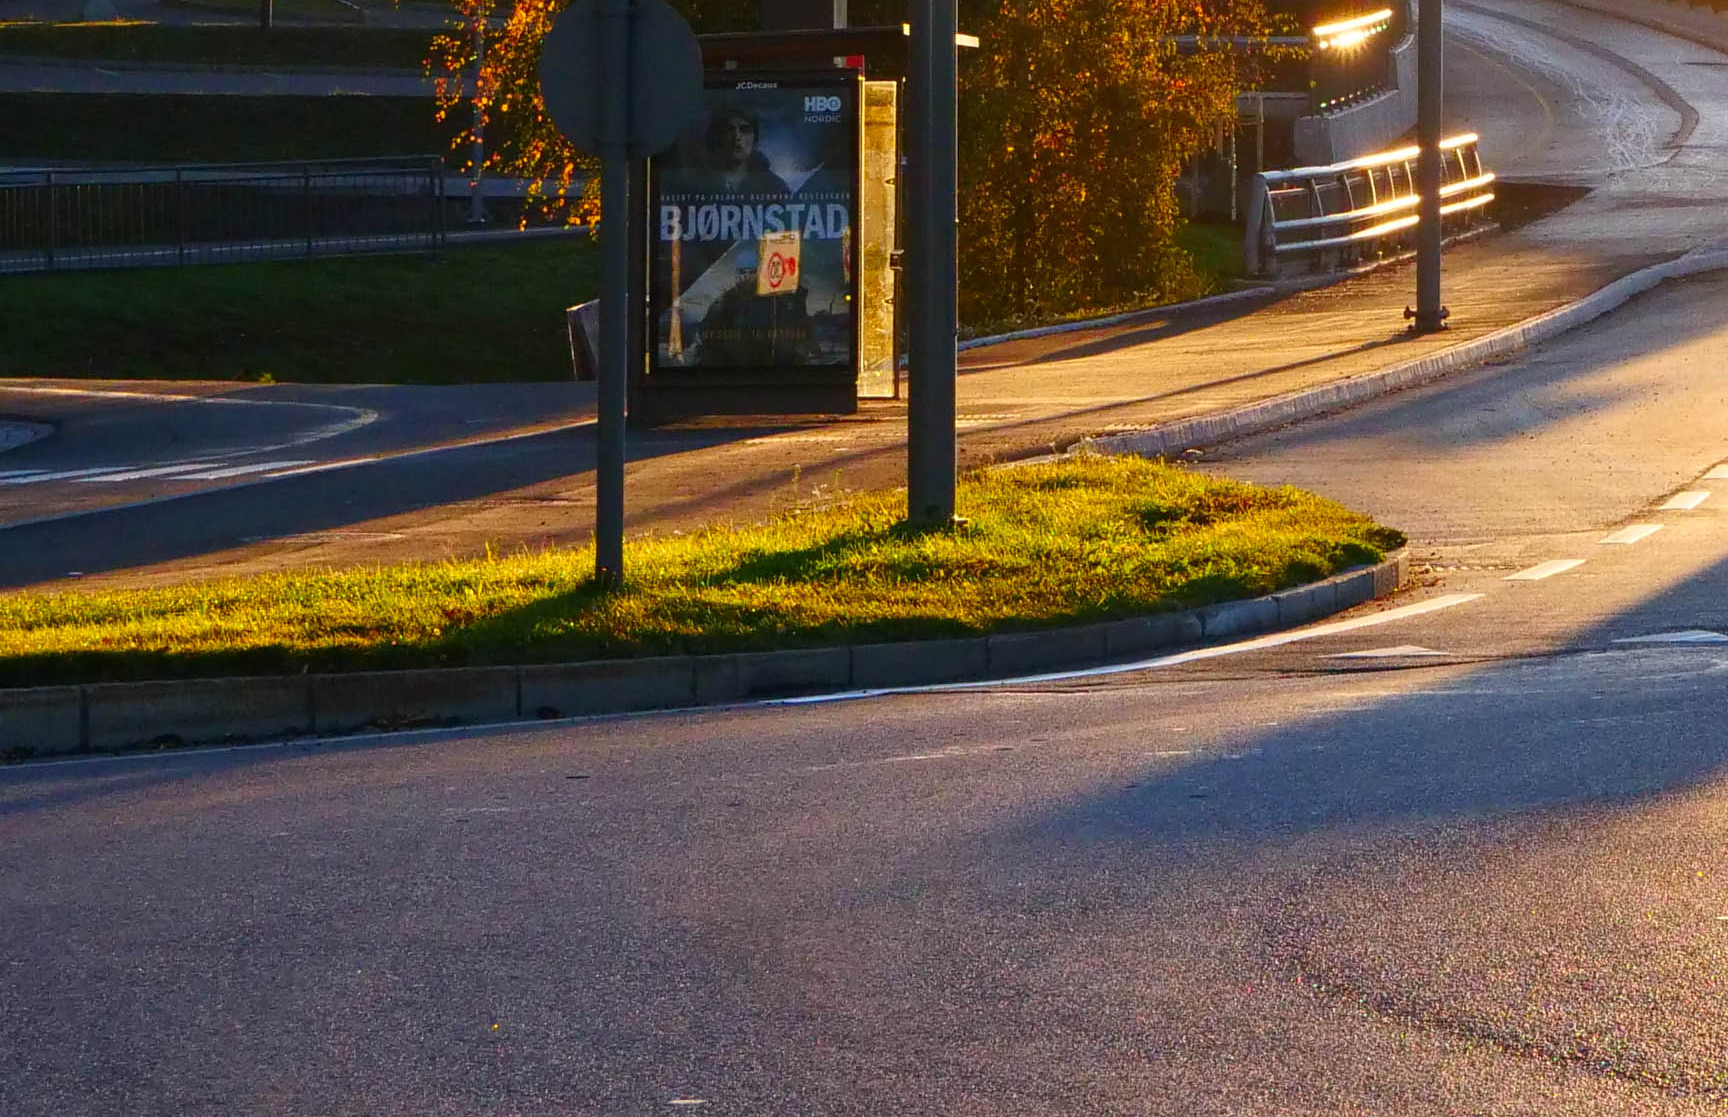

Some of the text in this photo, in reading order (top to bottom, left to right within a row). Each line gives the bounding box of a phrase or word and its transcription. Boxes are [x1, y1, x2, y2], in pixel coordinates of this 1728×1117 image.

[735, 82, 778, 90] JCDecaux
[803, 95, 842, 112] HBO
[803, 115, 842, 124] NORDIC
[660, 203, 849, 242] BJØRNSTAD
